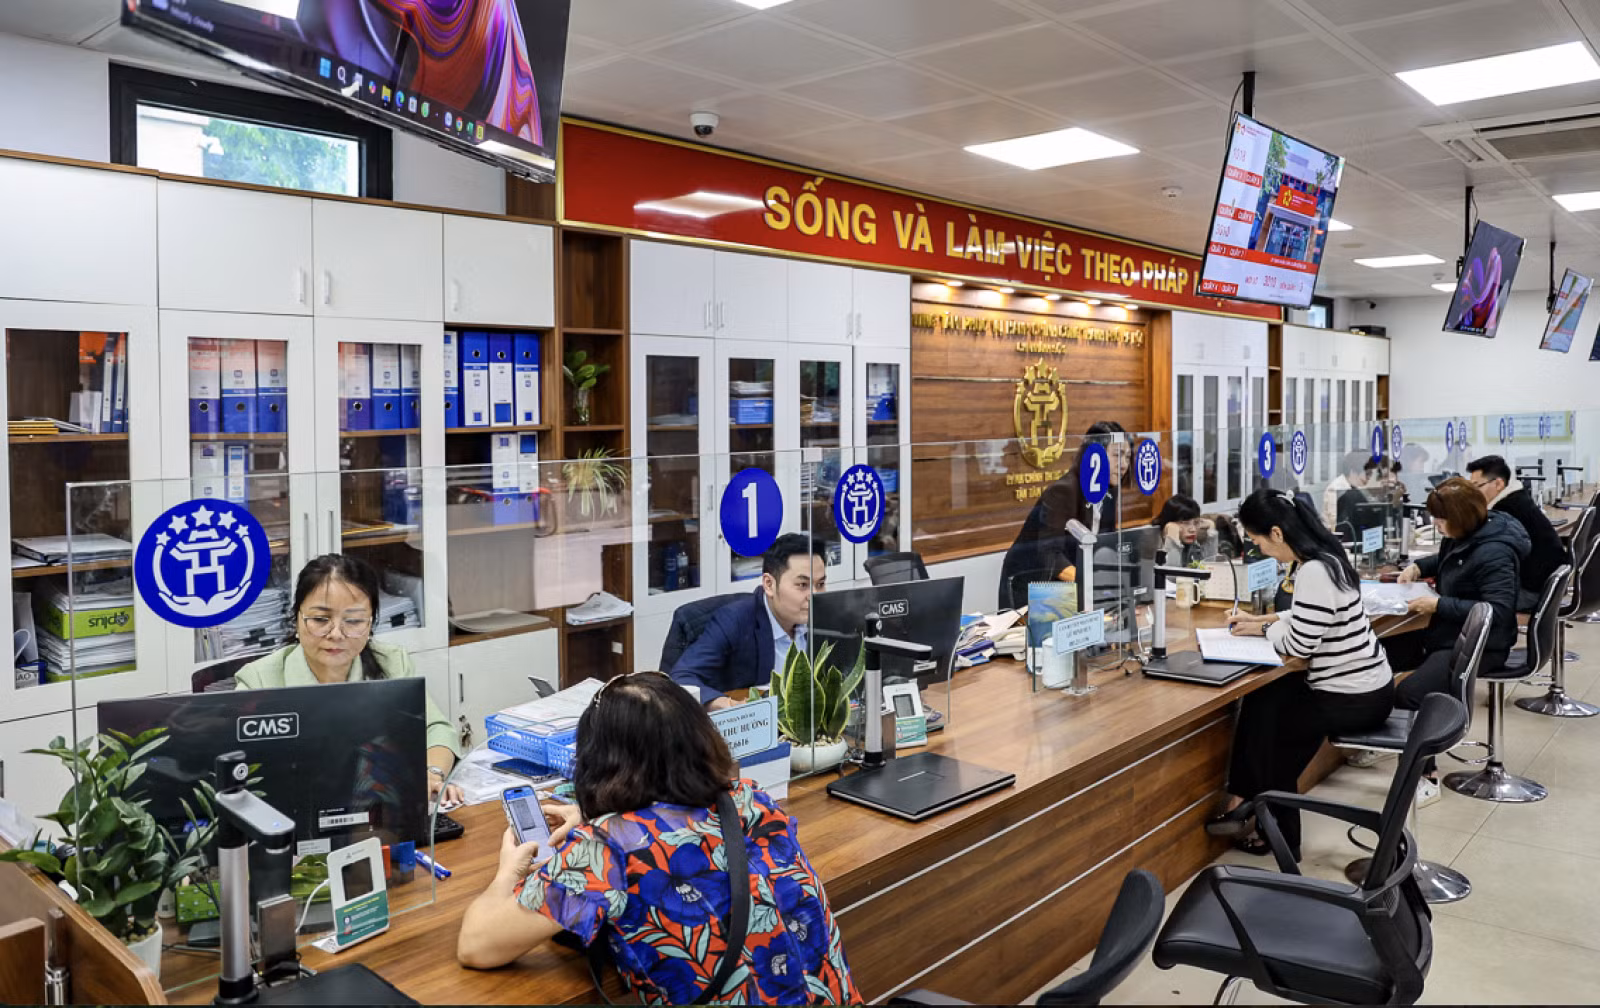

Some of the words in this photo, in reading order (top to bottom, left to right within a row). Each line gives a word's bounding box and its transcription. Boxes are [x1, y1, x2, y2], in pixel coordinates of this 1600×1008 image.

[764, 177, 877, 245] SỐNG
[892, 203, 935, 254] VÀ
[946, 214, 1005, 265] LÀM
[1016, 231, 1073, 281] VIỆC
[1080, 248, 1136, 287] THEO
[1142, 258, 1189, 294] PHÁP
[1089, 452, 1101, 493] 2
[1264, 440, 1272, 471] 3
[741, 482, 759, 539] 1
[881, 602, 905, 615] CMS
[243, 717, 291, 737] CMS
